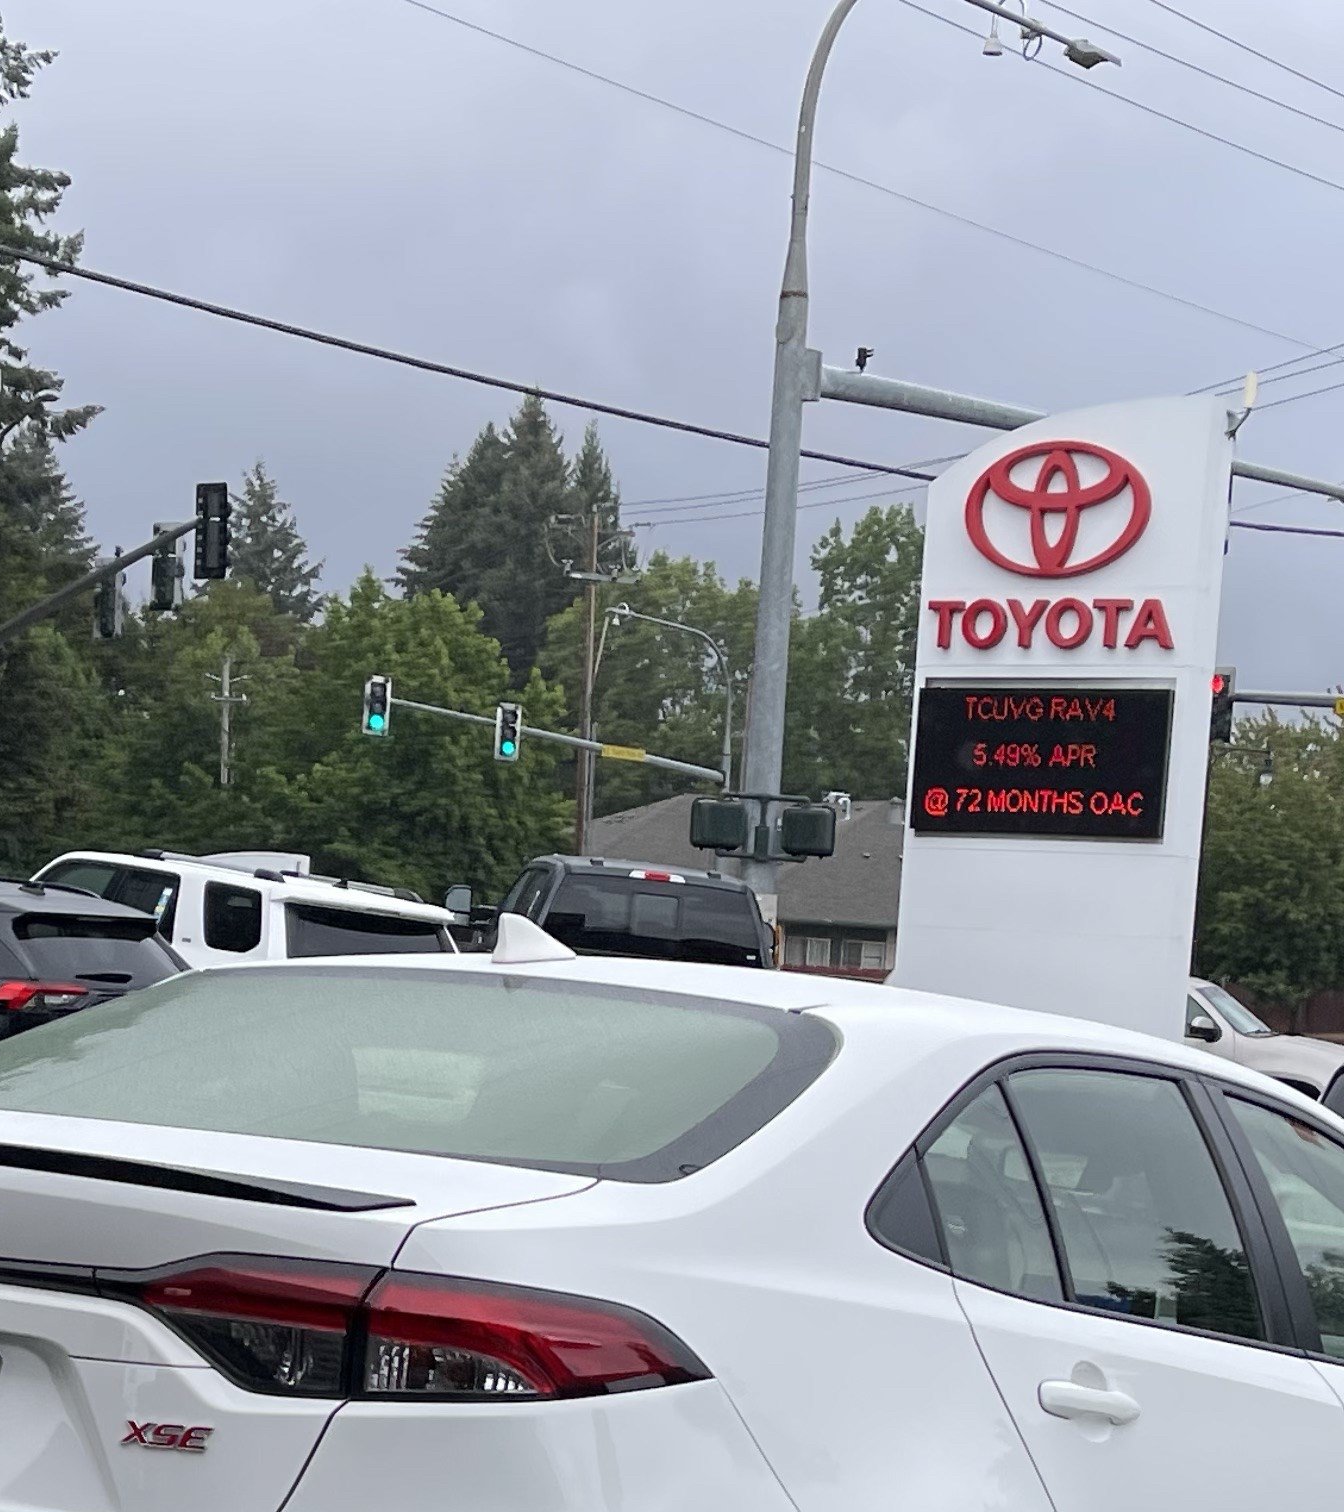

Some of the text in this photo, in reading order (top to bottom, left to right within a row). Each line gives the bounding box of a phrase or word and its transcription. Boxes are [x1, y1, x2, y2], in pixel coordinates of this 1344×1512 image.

[928, 598, 1174, 649] TOYOTA
[965, 695, 1116, 721] TCUVG RAV4
[972, 743, 1097, 768] 5.49% APR
[924, 787, 1143, 816] @ 72 MONTHS OAC
[121, 1420, 214, 1452] XSE
